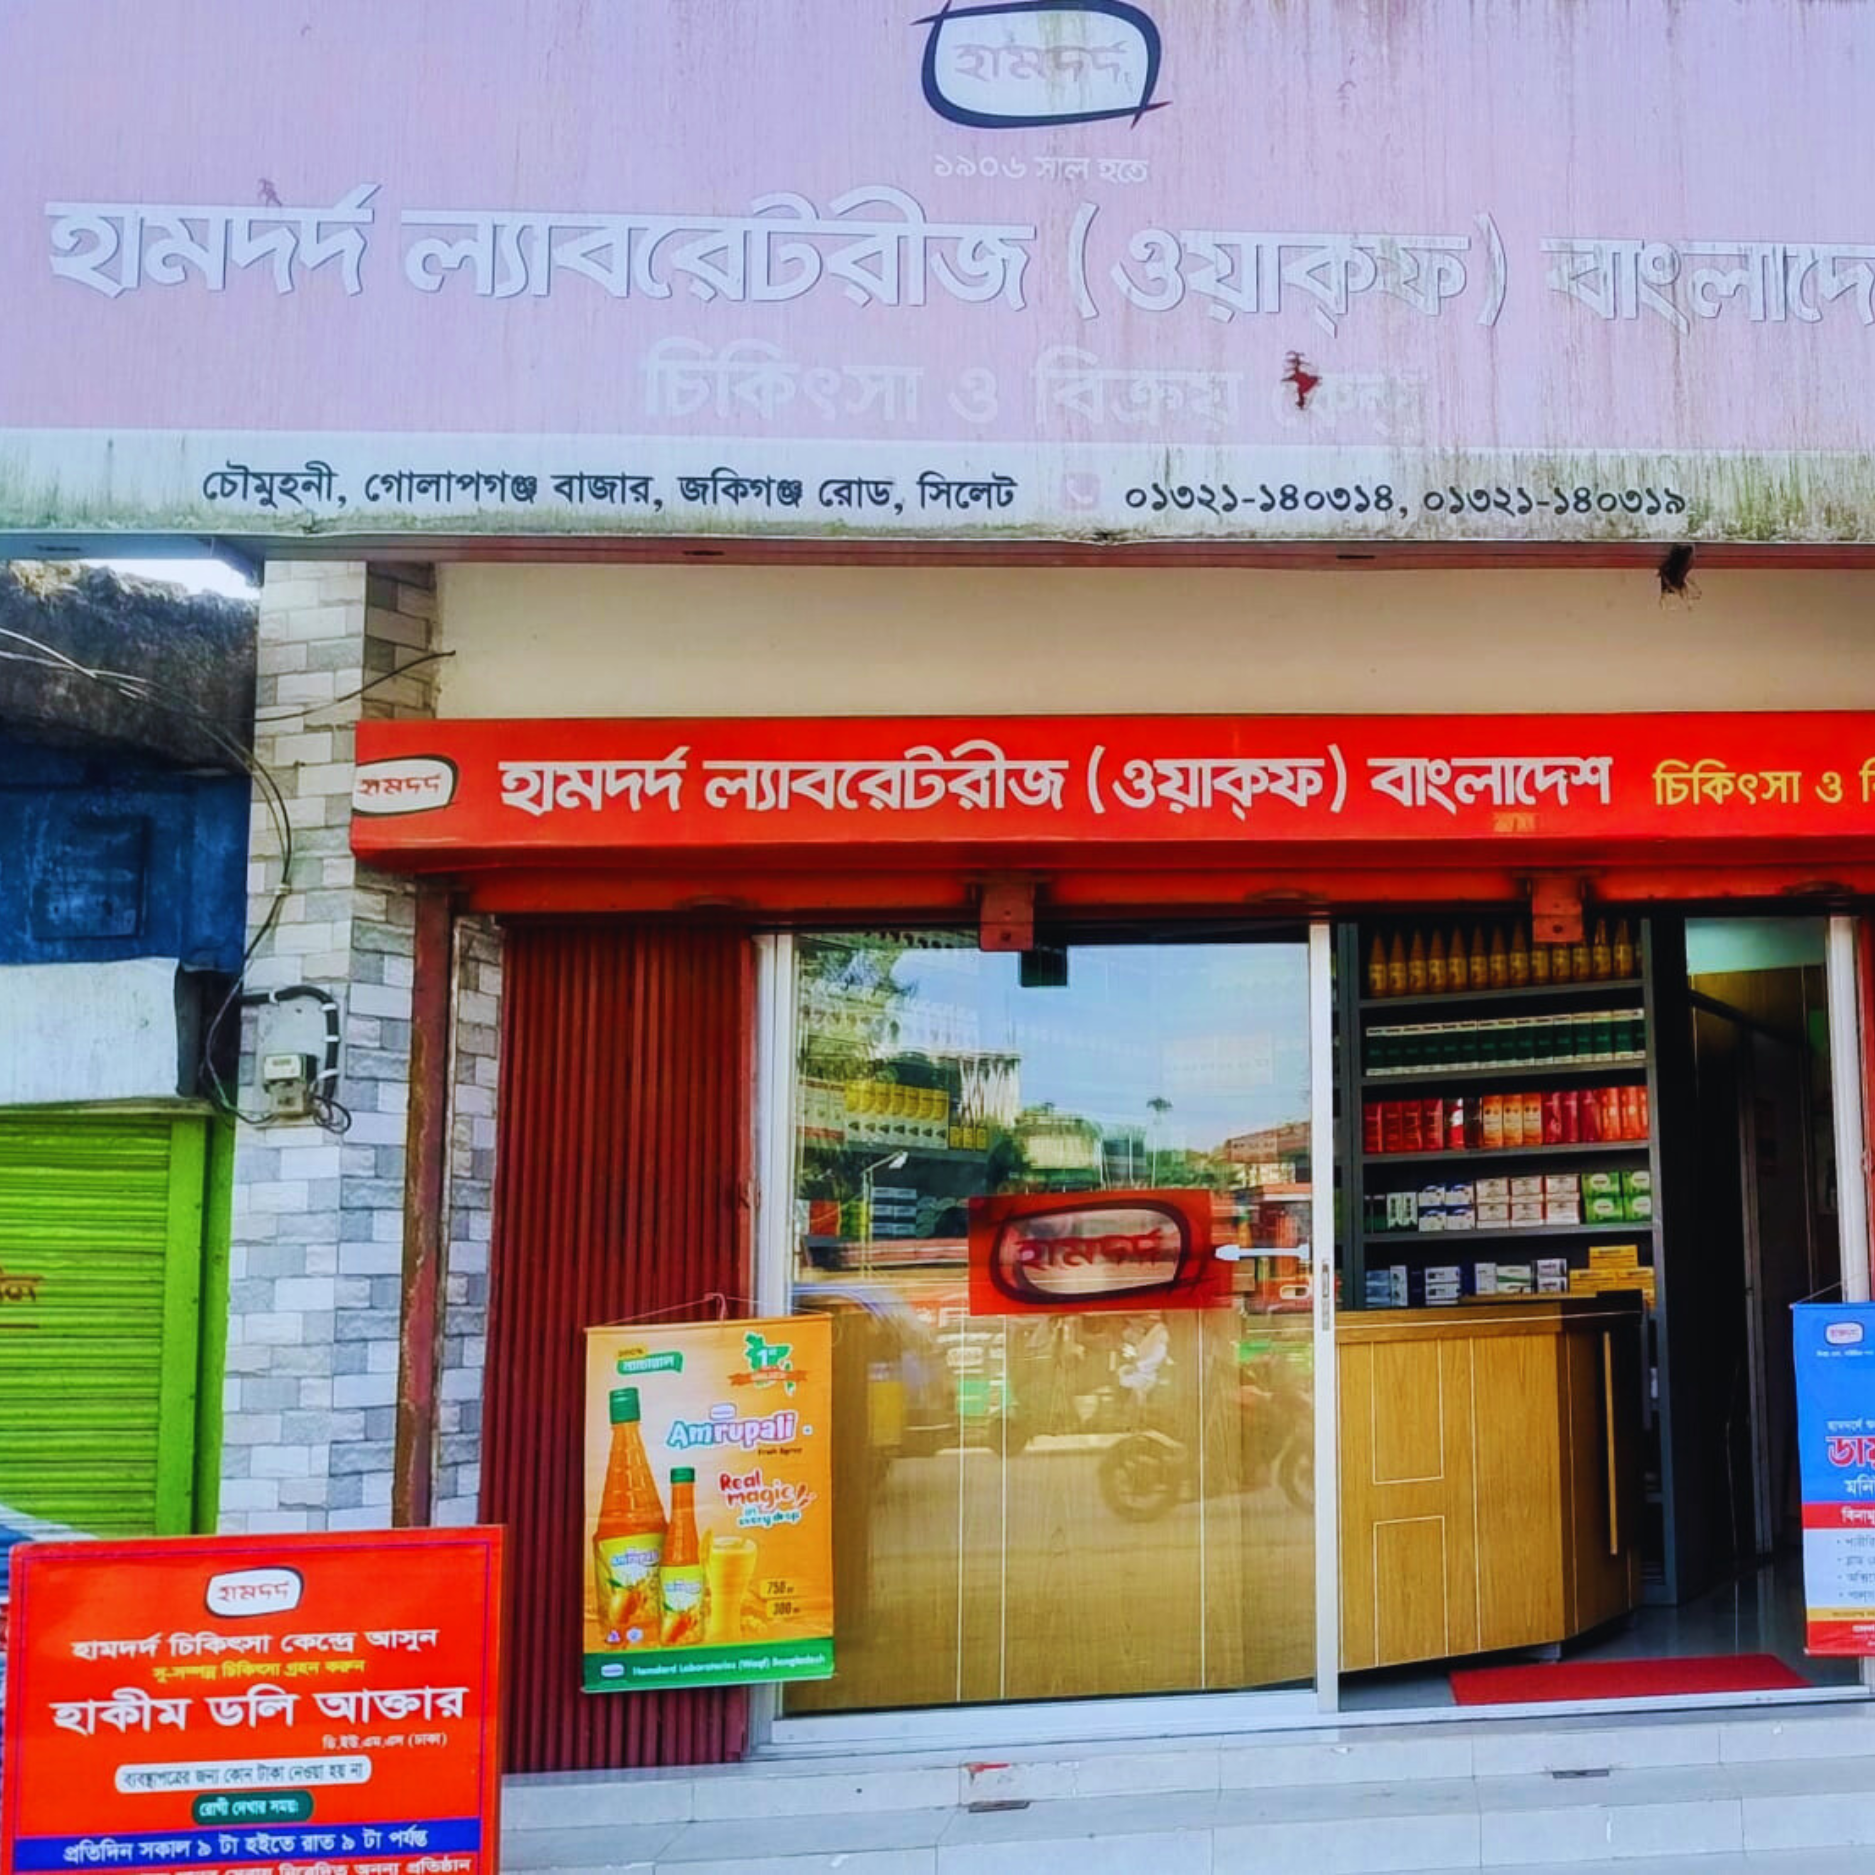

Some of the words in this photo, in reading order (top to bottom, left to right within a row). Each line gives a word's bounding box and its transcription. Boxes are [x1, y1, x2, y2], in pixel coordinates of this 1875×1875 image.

[934, 154, 1027, 179] ১৯০৬
[1033, 155, 1091, 182] সাল
[1097, 157, 1149, 184] হতে
[45, 183, 382, 299] হামদর্দ
[399, 185, 1037, 312] ল্যাবরেটরীজ
[638, 336, 924, 421] চিকিৎসা
[947, 366, 999, 425] ও
[202, 460, 347, 509] চৌমুহনী,
[364, 469, 538, 504] গোলাপগঞ্জ
[550, 471, 663, 512] বাজার,
[677, 466, 803, 508] জকিগঞ্জ
[819, 475, 903, 515] রোড,
[916, 470, 1019, 510] সিলেট
[1125, 483, 1408, 521] ০১৩২১-১৪০৩১৪,
[1422, 485, 1687, 516] ০১৩২১-১৪০৩১৯
[498, 746, 691, 817] হামদর্দ
[703, 740, 1070, 812] ল্যাবরেটরীজ
[1368, 755, 1613, 817] বাংলাদেশ
[1652, 758, 1802, 805] চিকিৎসা
[1814, 771, 1843, 804] ও
[668, 1412, 796, 1449] Amrupali
[719, 1470, 761, 1491] Real
[727, 1480, 794, 1509] magic
[72, 1632, 161, 1661] হামদর্দ
[169, 1630, 272, 1658] চিকিৎসা
[280, 1632, 357, 1653] কেন্দ্রে
[364, 1628, 440, 1652] আসুন
[51, 1687, 194, 1736] হাকীম
[204, 1683, 301, 1729] ডলি
[312, 1685, 470, 1725] আক্তার
[257, 1764, 284, 1781] টাকা
[63, 1838, 134, 1864] প্রতিদিন
[138, 1839, 192, 1860] সকাল
[197, 1839, 213, 1858] ৯
[217, 1832, 239, 1855] টা
[244, 1831, 296, 1856] হইতে
[300, 1832, 337, 1854] রাত
[342, 1833, 356, 1852] ৯
[362, 1827, 382, 1850] টা
